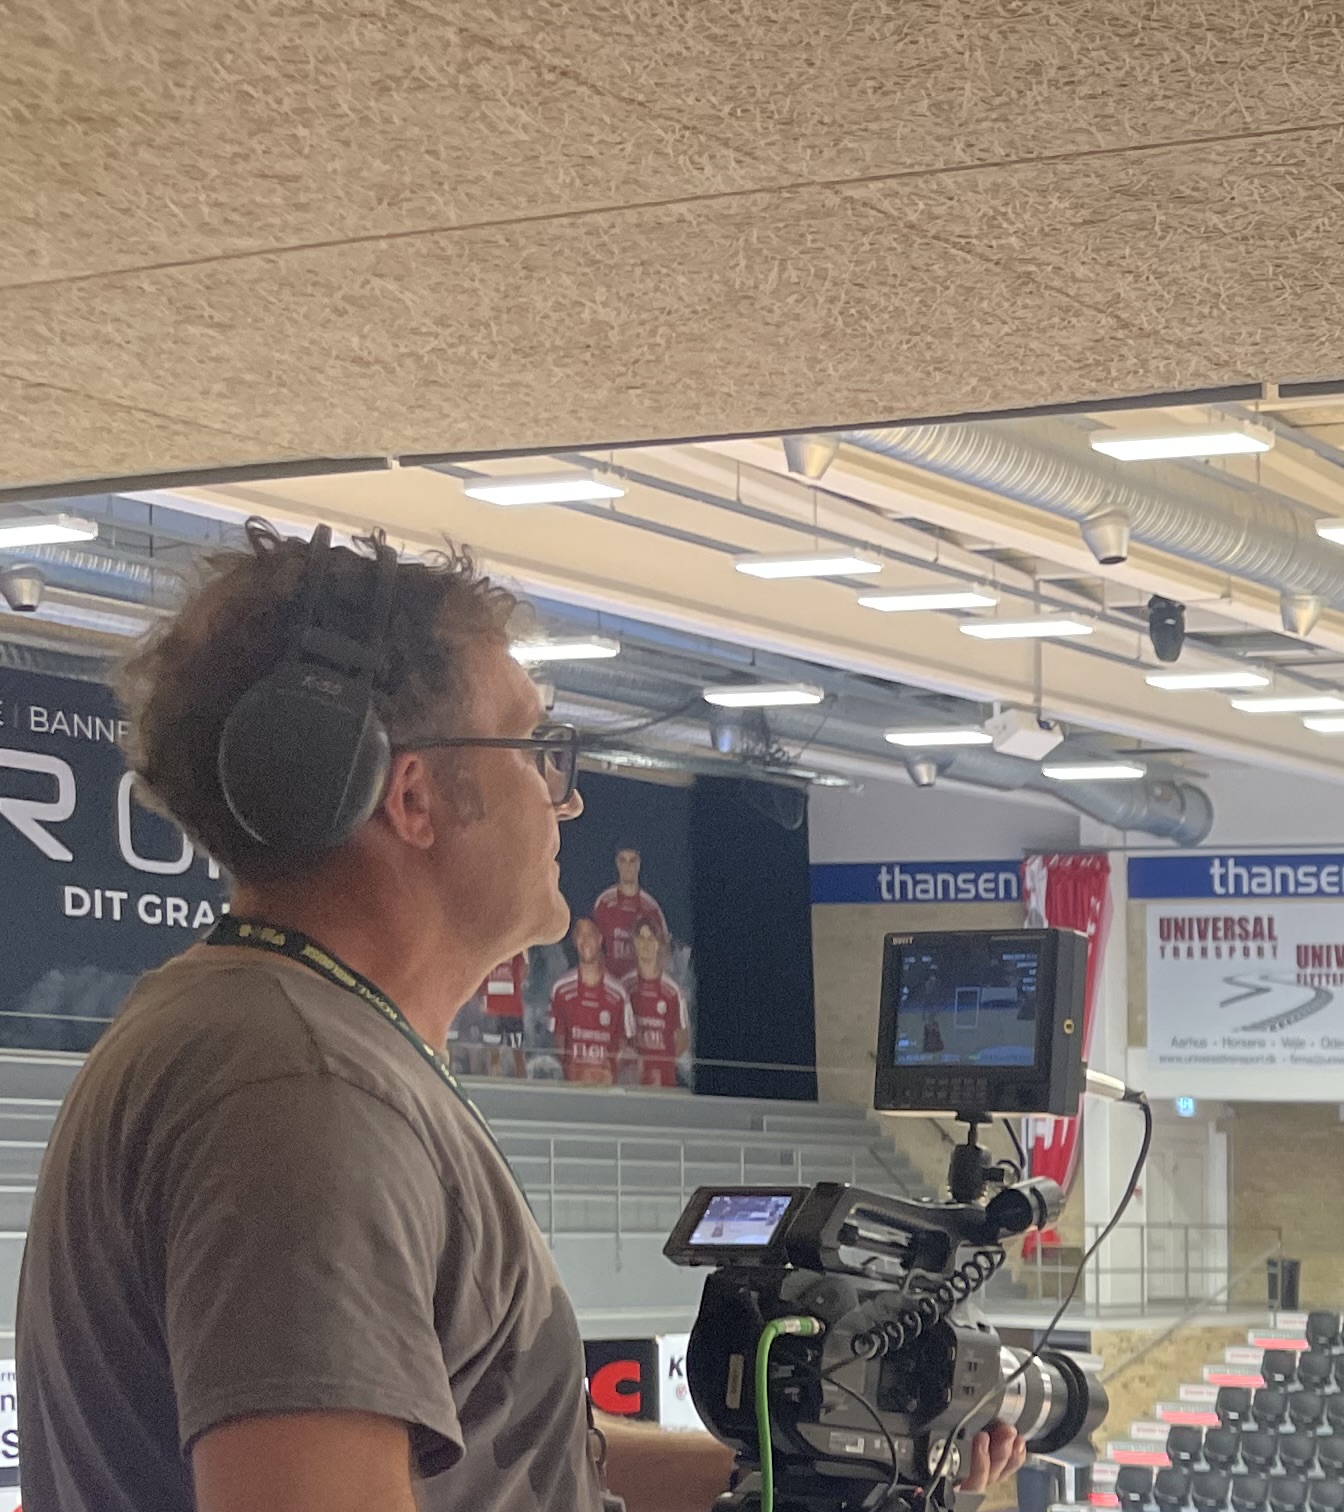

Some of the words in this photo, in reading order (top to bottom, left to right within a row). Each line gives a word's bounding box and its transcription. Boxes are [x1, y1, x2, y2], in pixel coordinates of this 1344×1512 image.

[877, 864, 1019, 901] thansen
[64, 885, 128, 921] DIT
[137, 893, 231, 929] GRA
[1159, 915, 1278, 942] UNIVERSAL
